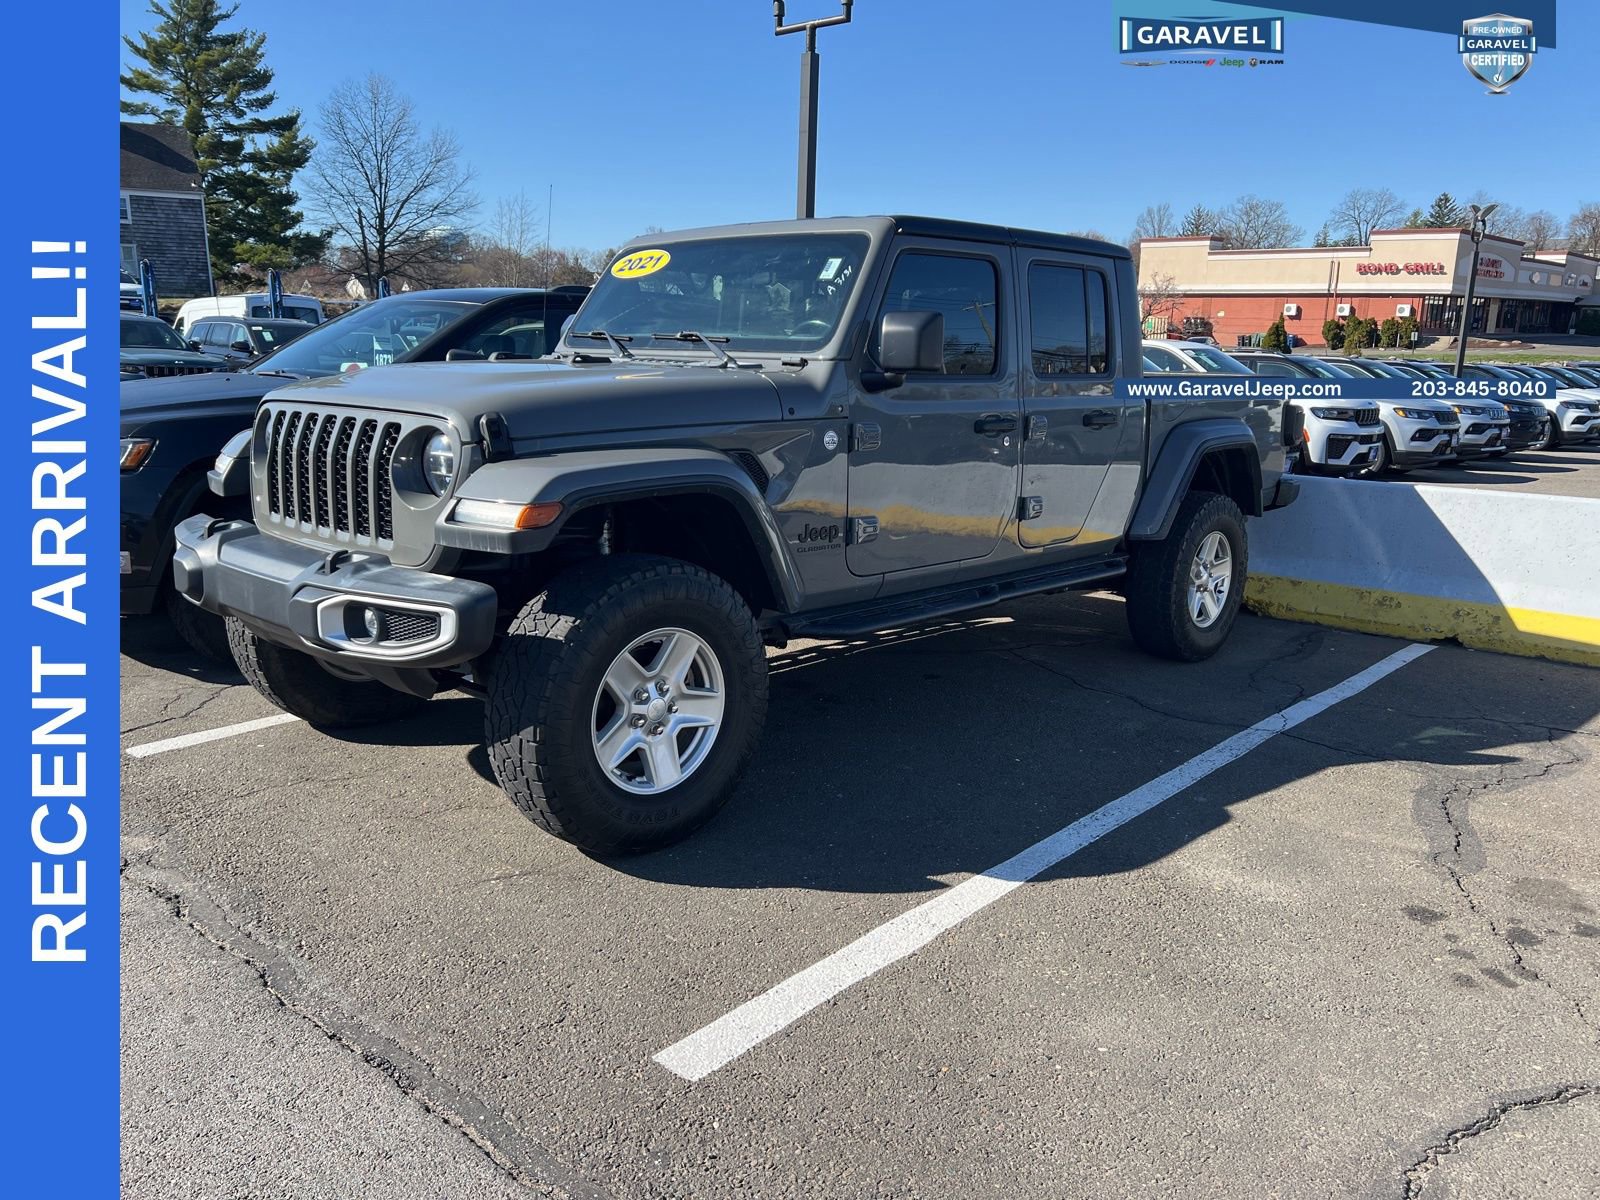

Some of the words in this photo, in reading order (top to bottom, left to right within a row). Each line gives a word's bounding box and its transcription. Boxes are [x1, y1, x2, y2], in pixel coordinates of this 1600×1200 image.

[616, 254, 665, 273] 2021
[1356, 262, 1398, 274] BOND
[1403, 262, 1446, 275] GRILL
[798, 523, 840, 543] Jeep
[796, 543, 842, 553] GLADIATOR
